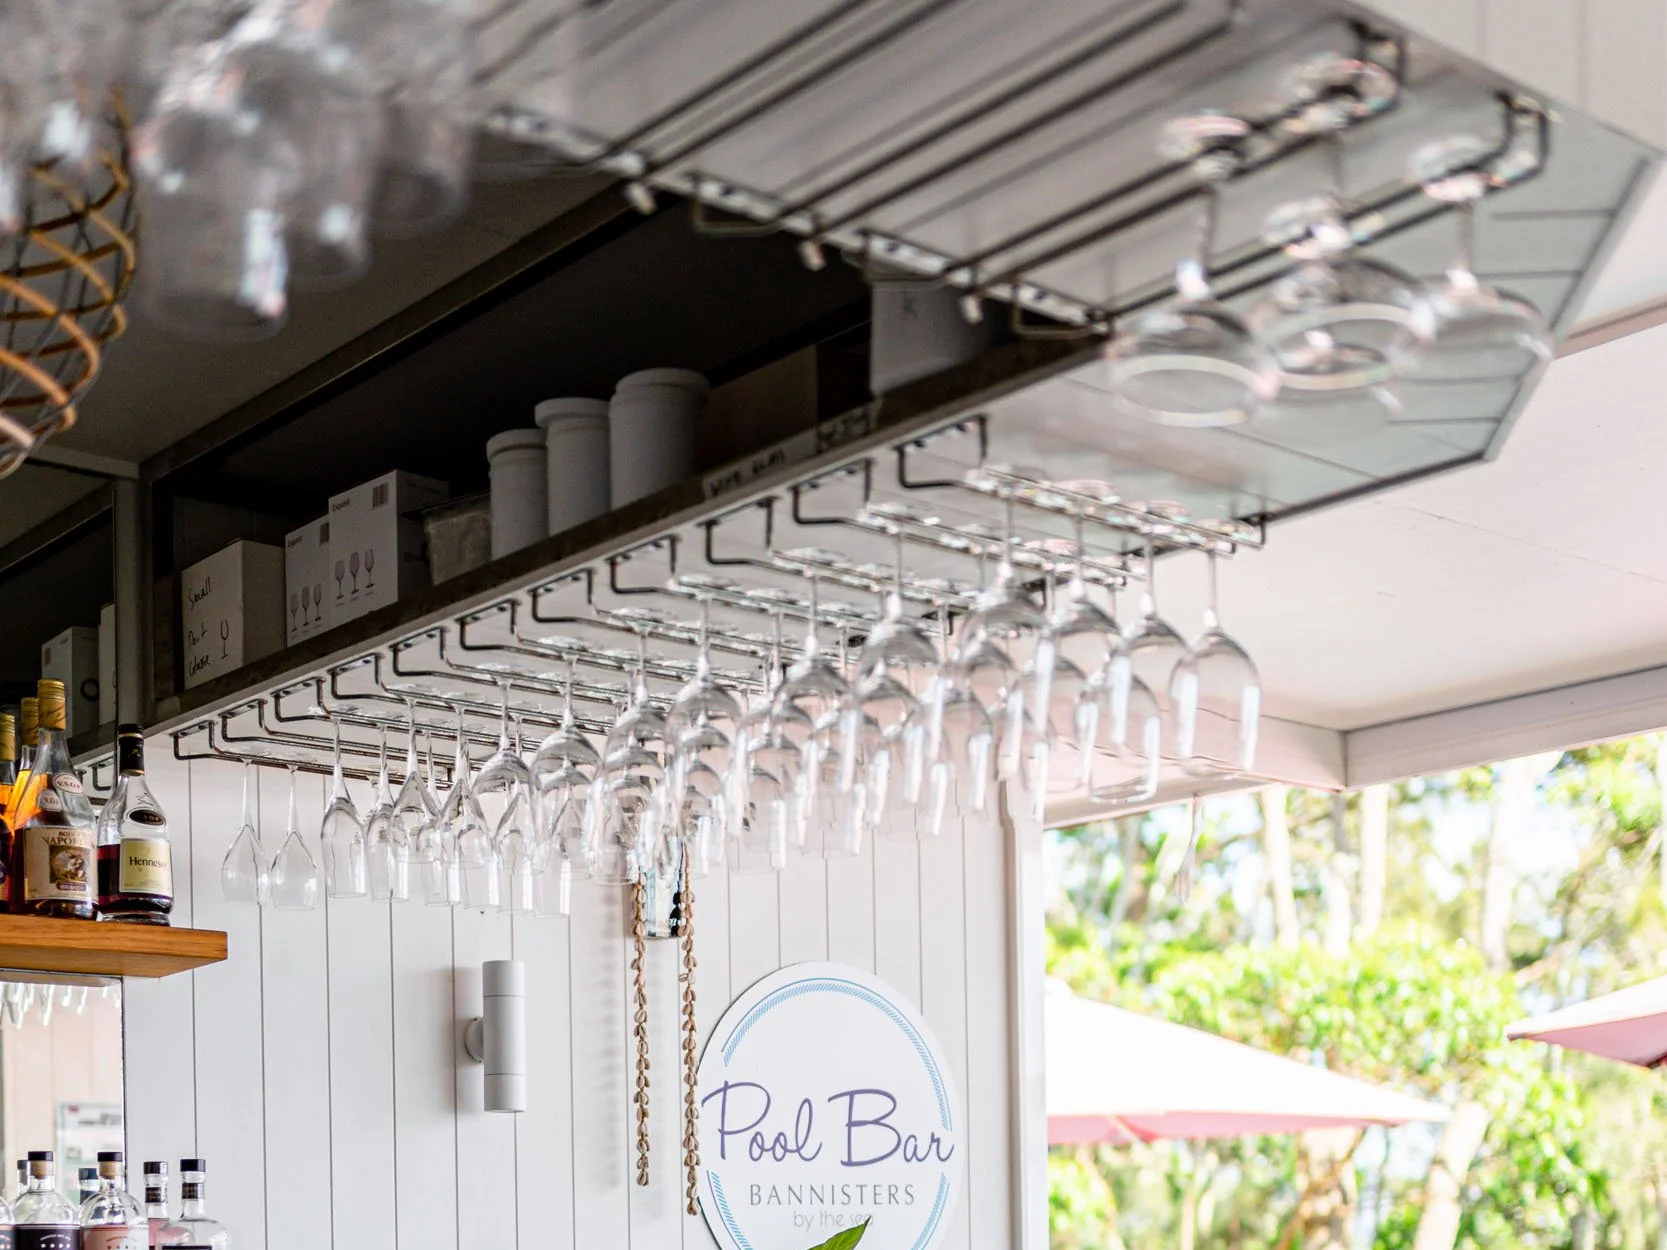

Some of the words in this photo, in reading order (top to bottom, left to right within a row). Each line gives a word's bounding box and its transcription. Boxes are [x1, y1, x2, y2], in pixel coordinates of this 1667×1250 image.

[701, 1080, 823, 1162] Pool
[827, 1088, 955, 1167] Bar
[749, 1184, 915, 1206] BANNISTERS
[793, 1210, 814, 1232] by
[819, 1210, 843, 1227] the
